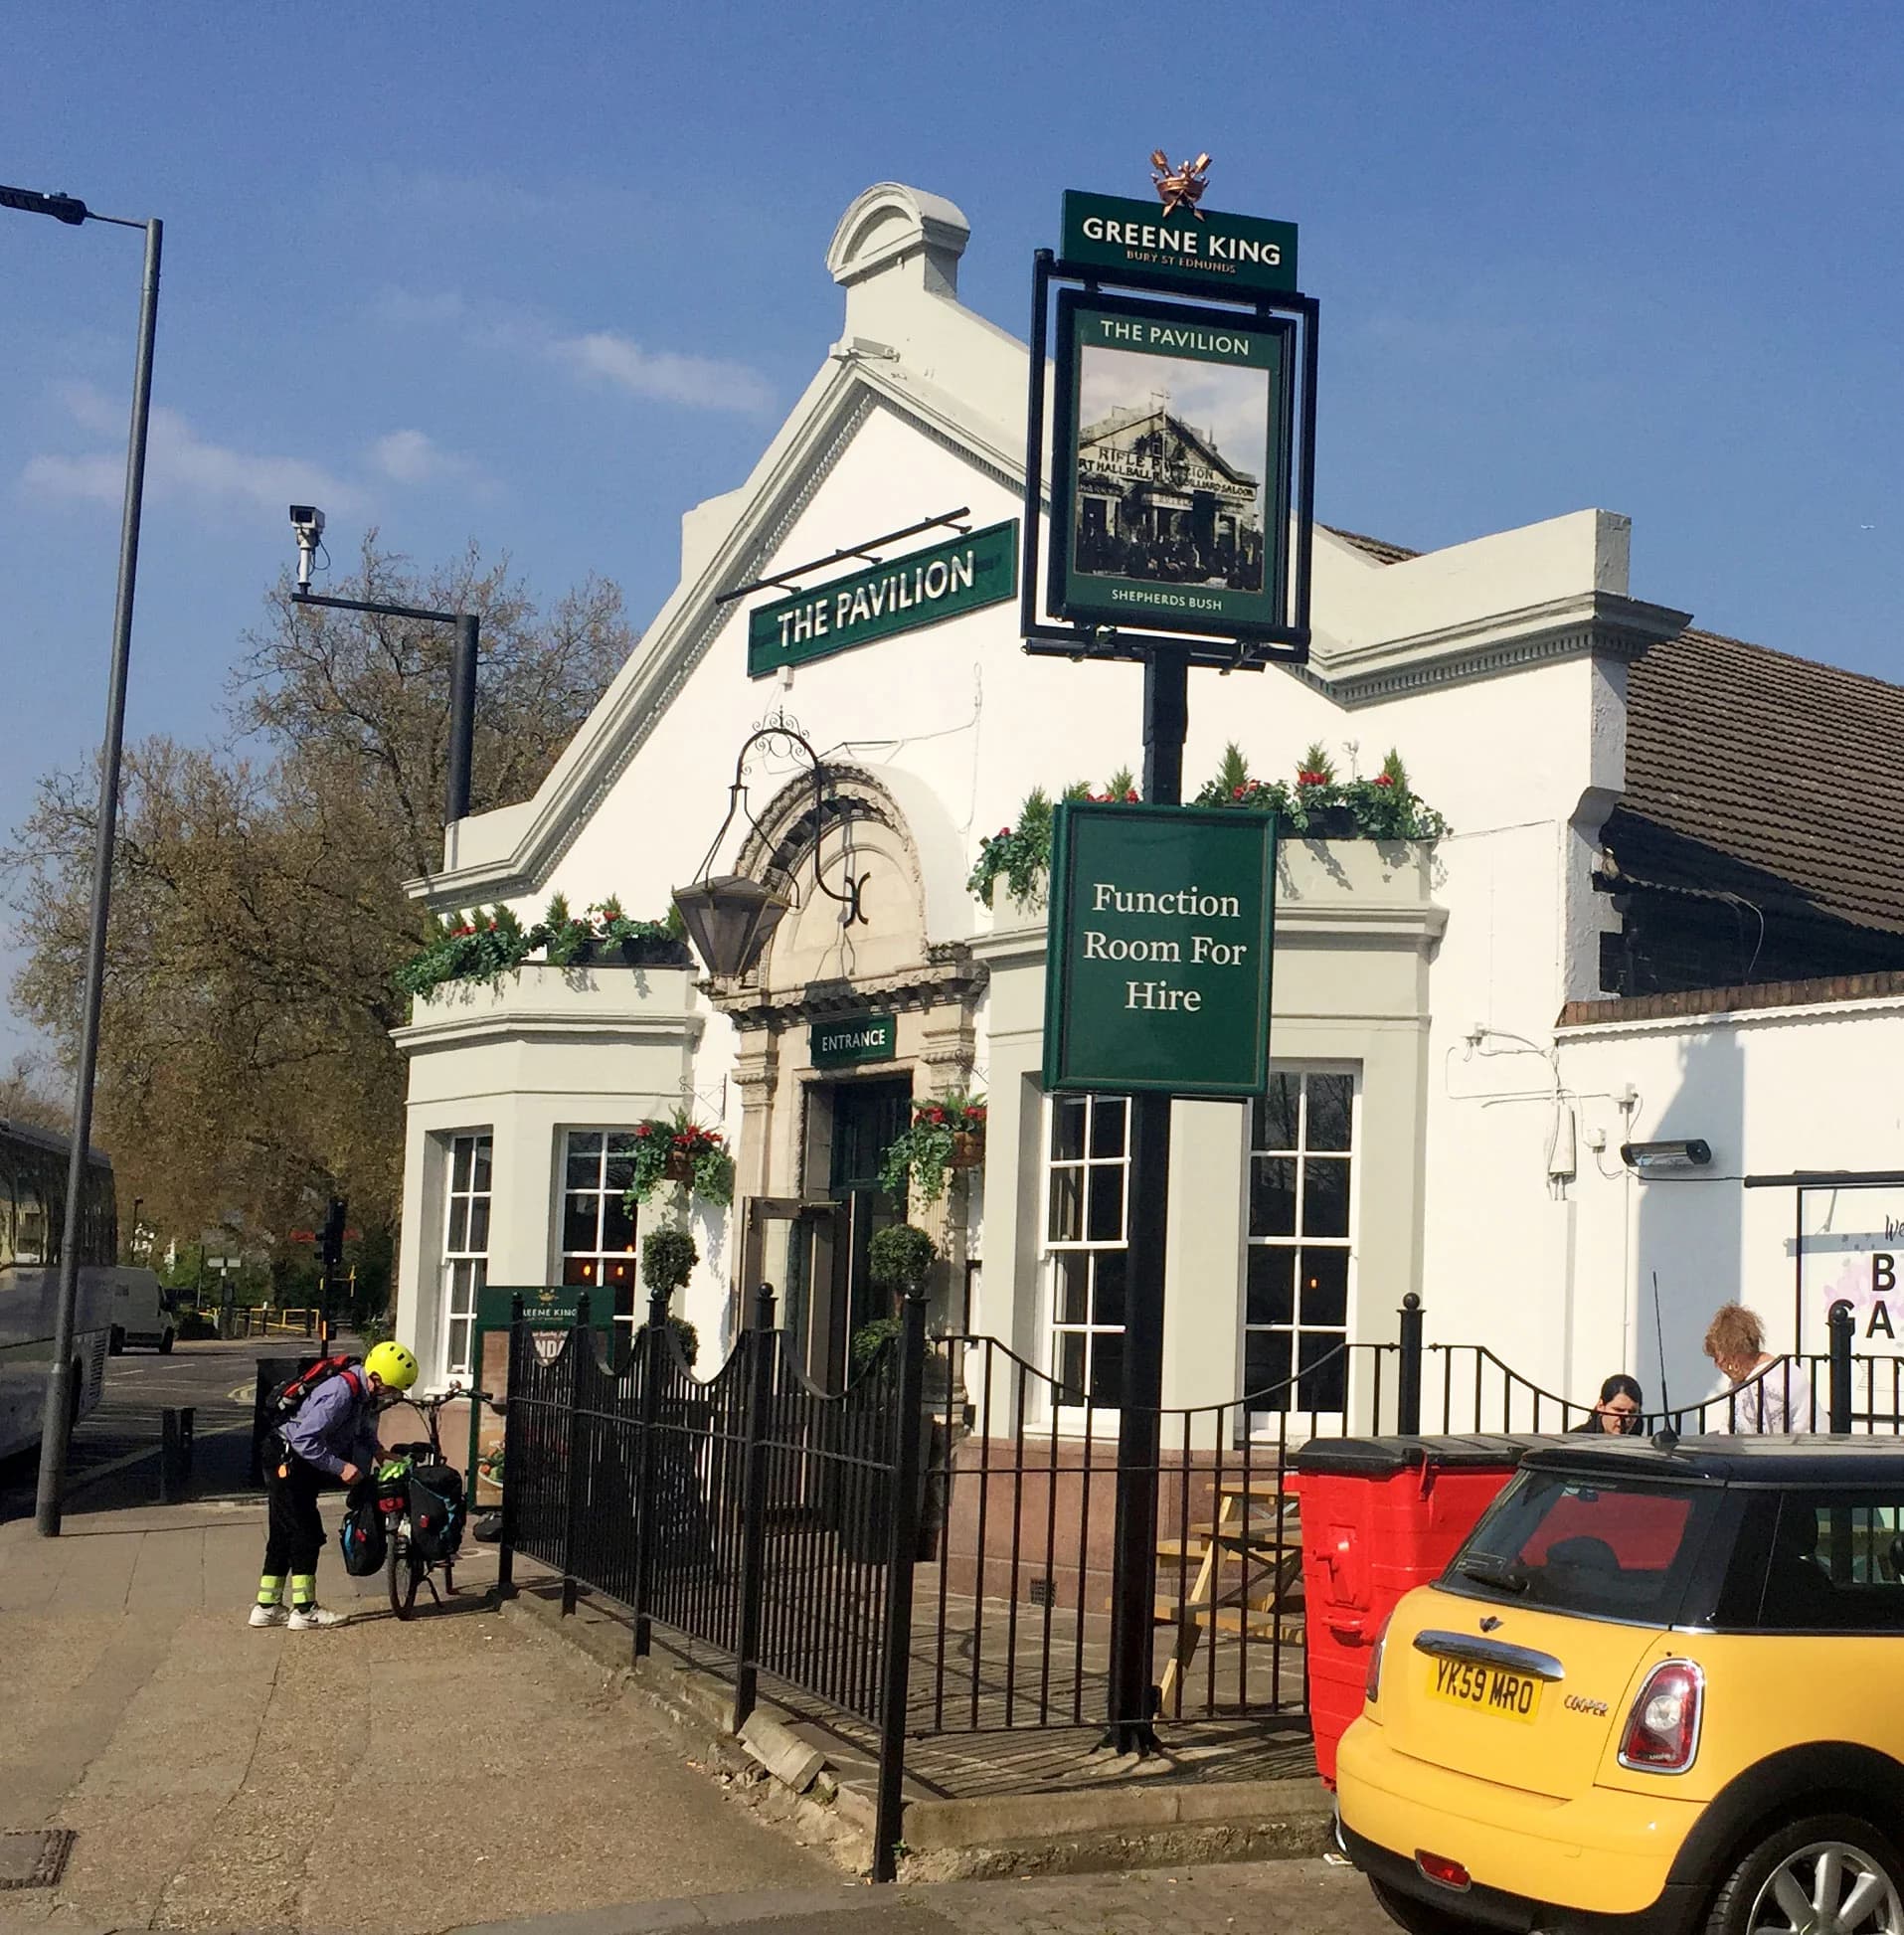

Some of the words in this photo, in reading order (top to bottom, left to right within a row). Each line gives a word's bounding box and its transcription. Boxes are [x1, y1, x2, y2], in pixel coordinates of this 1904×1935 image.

[1083, 218, 1198, 256] GREENE
[1209, 237, 1281, 265] KING
[1126, 250, 1158, 264] BURY
[1161, 255, 1175, 265] ST
[1179, 257, 1237, 274] EDMUNDS
[1100, 319, 1142, 342] THE
[1149, 326, 1250, 355] PAVILION
[1099, 448, 1145, 467] RIFLE
[778, 599, 829, 647] THE
[836, 550, 974, 629] PAVILION
[1112, 589, 1186, 608] SHEPHERDS
[1188, 597, 1223, 612] BUSH
[1092, 883, 1241, 918] Function
[1083, 931, 1181, 964] Room
[1189, 937, 1248, 966] For
[1125, 980, 1202, 1012] Hire
[821, 1028, 886, 1052] ENTRANCE
[1437, 1658, 1487, 1702] YK59
[1488, 1671, 1534, 1714] MRO
[1564, 1694, 1609, 1717] COOPER
